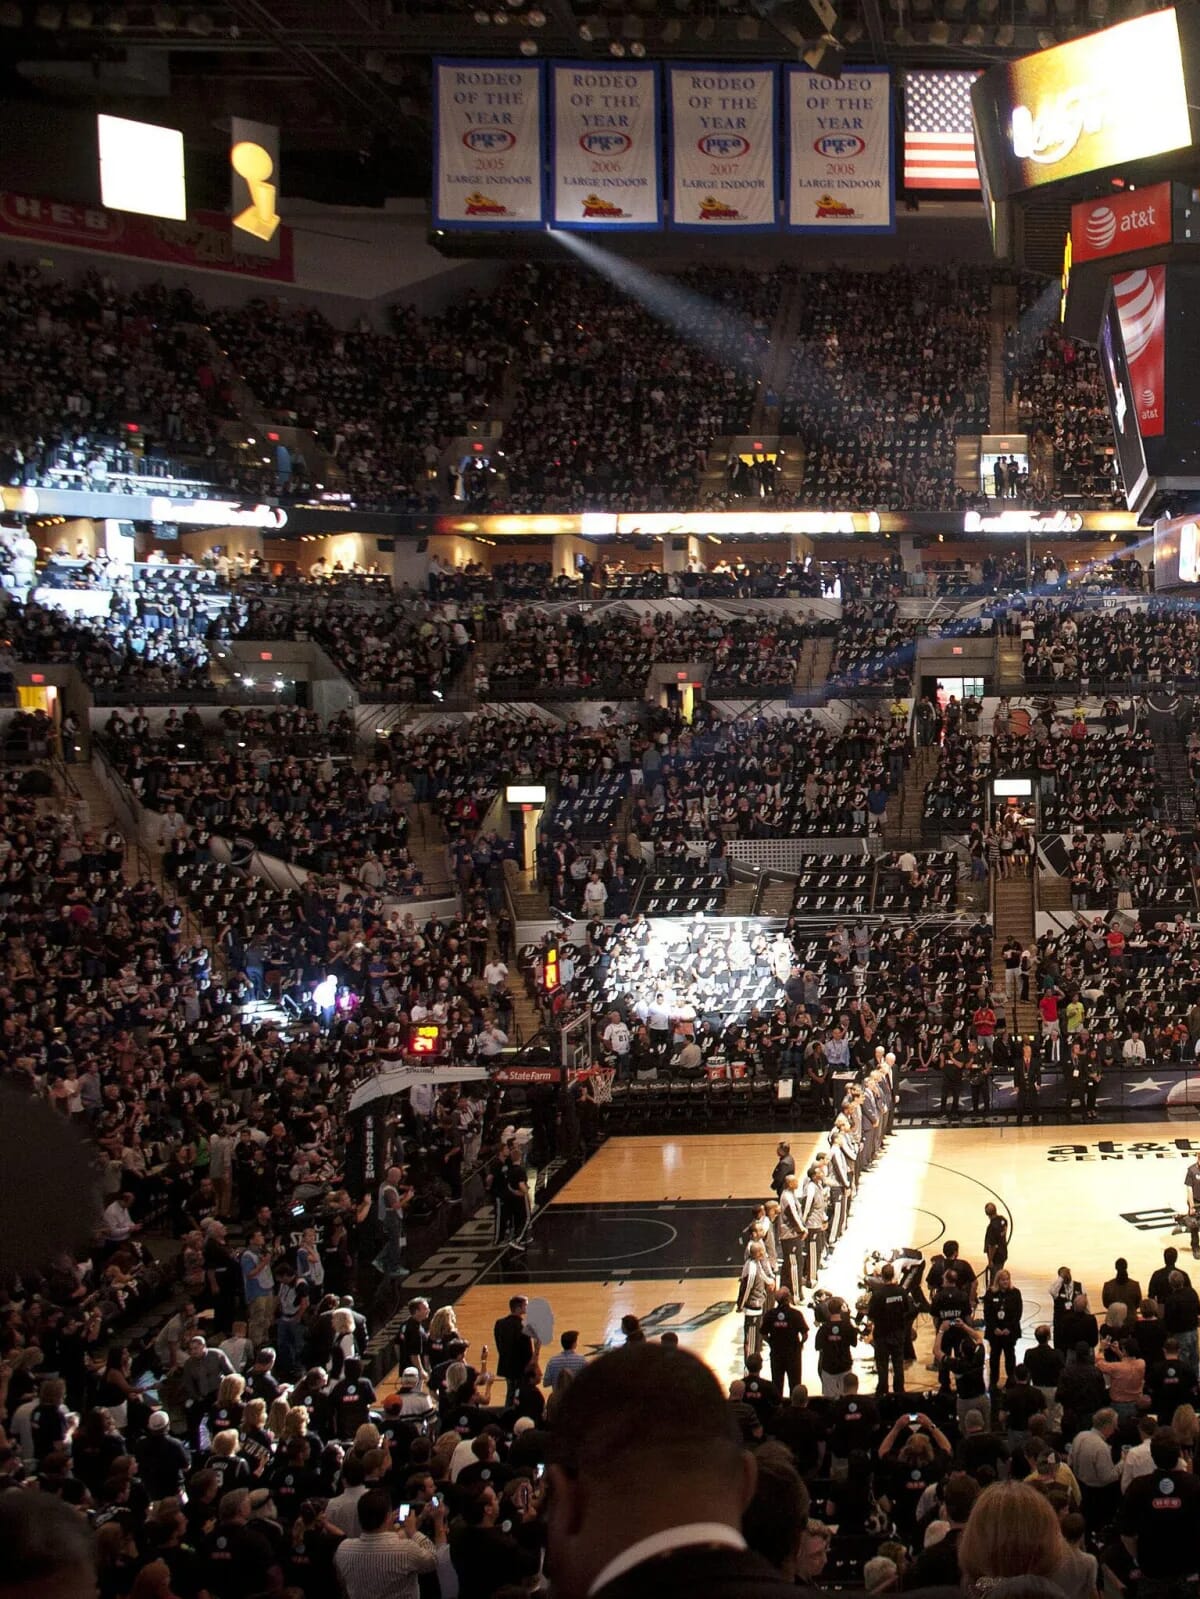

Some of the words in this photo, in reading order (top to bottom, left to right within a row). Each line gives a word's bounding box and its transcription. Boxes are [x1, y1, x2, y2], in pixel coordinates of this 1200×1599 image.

[455, 72, 522, 86] RODEO
[573, 74, 638, 88] RODEO
[691, 77, 756, 90] RODEO
[809, 78, 872, 91] RODEO
[454, 92, 479, 105] OF
[486, 92, 523, 105] THE
[570, 95, 595, 107] OF
[604, 95, 640, 108] THE
[689, 97, 713, 109] OF
[721, 97, 758, 110] THE
[806, 97, 831, 109] OF
[838, 97, 873, 110] THE
[464, 112, 513, 125] YEAR
[581, 114, 630, 127] YEAR
[700, 116, 747, 129] YEAR
[817, 117, 864, 129] YEAR
[709, 164, 739, 175] 2007
[826, 164, 855, 175] 2008
[447, 175, 483, 185] LARGE
[486, 175, 533, 185] INDOOR
[563, 176, 599, 186] LARGE
[602, 177, 648, 187] INDOOR
[682, 179, 718, 188] LARGE
[721, 179, 766, 189] INDOOR
[799, 179, 835, 188] LARGE
[837, 179, 881, 188] INDOOR
[1120, 206, 1156, 232] at&t
[1142, 408, 1159, 420] at&t
[1047, 1152, 1199, 1162] CENTER
